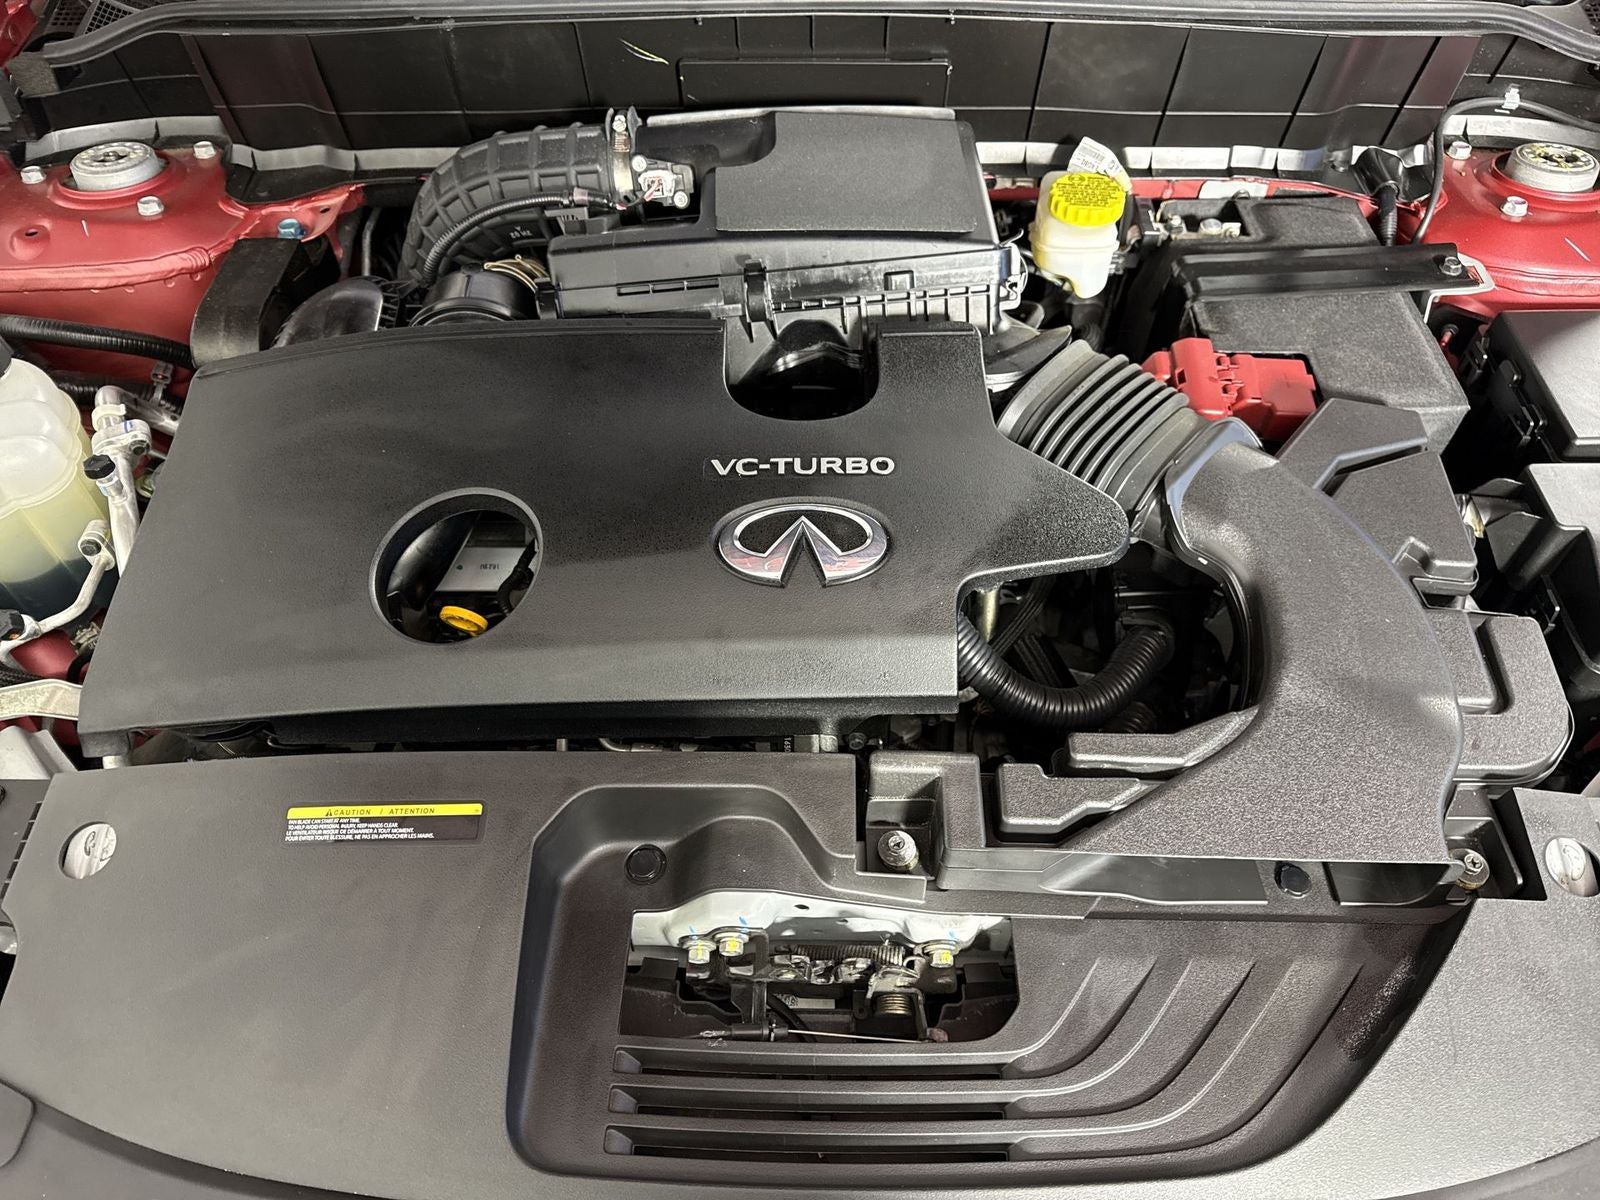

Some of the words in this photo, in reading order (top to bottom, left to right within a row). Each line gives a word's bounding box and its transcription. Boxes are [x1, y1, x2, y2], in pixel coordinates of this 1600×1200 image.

[711, 457, 895, 476] VC-TURBO
[334, 808, 371, 816] CAUTION
[389, 807, 435, 815] ATTENTION
